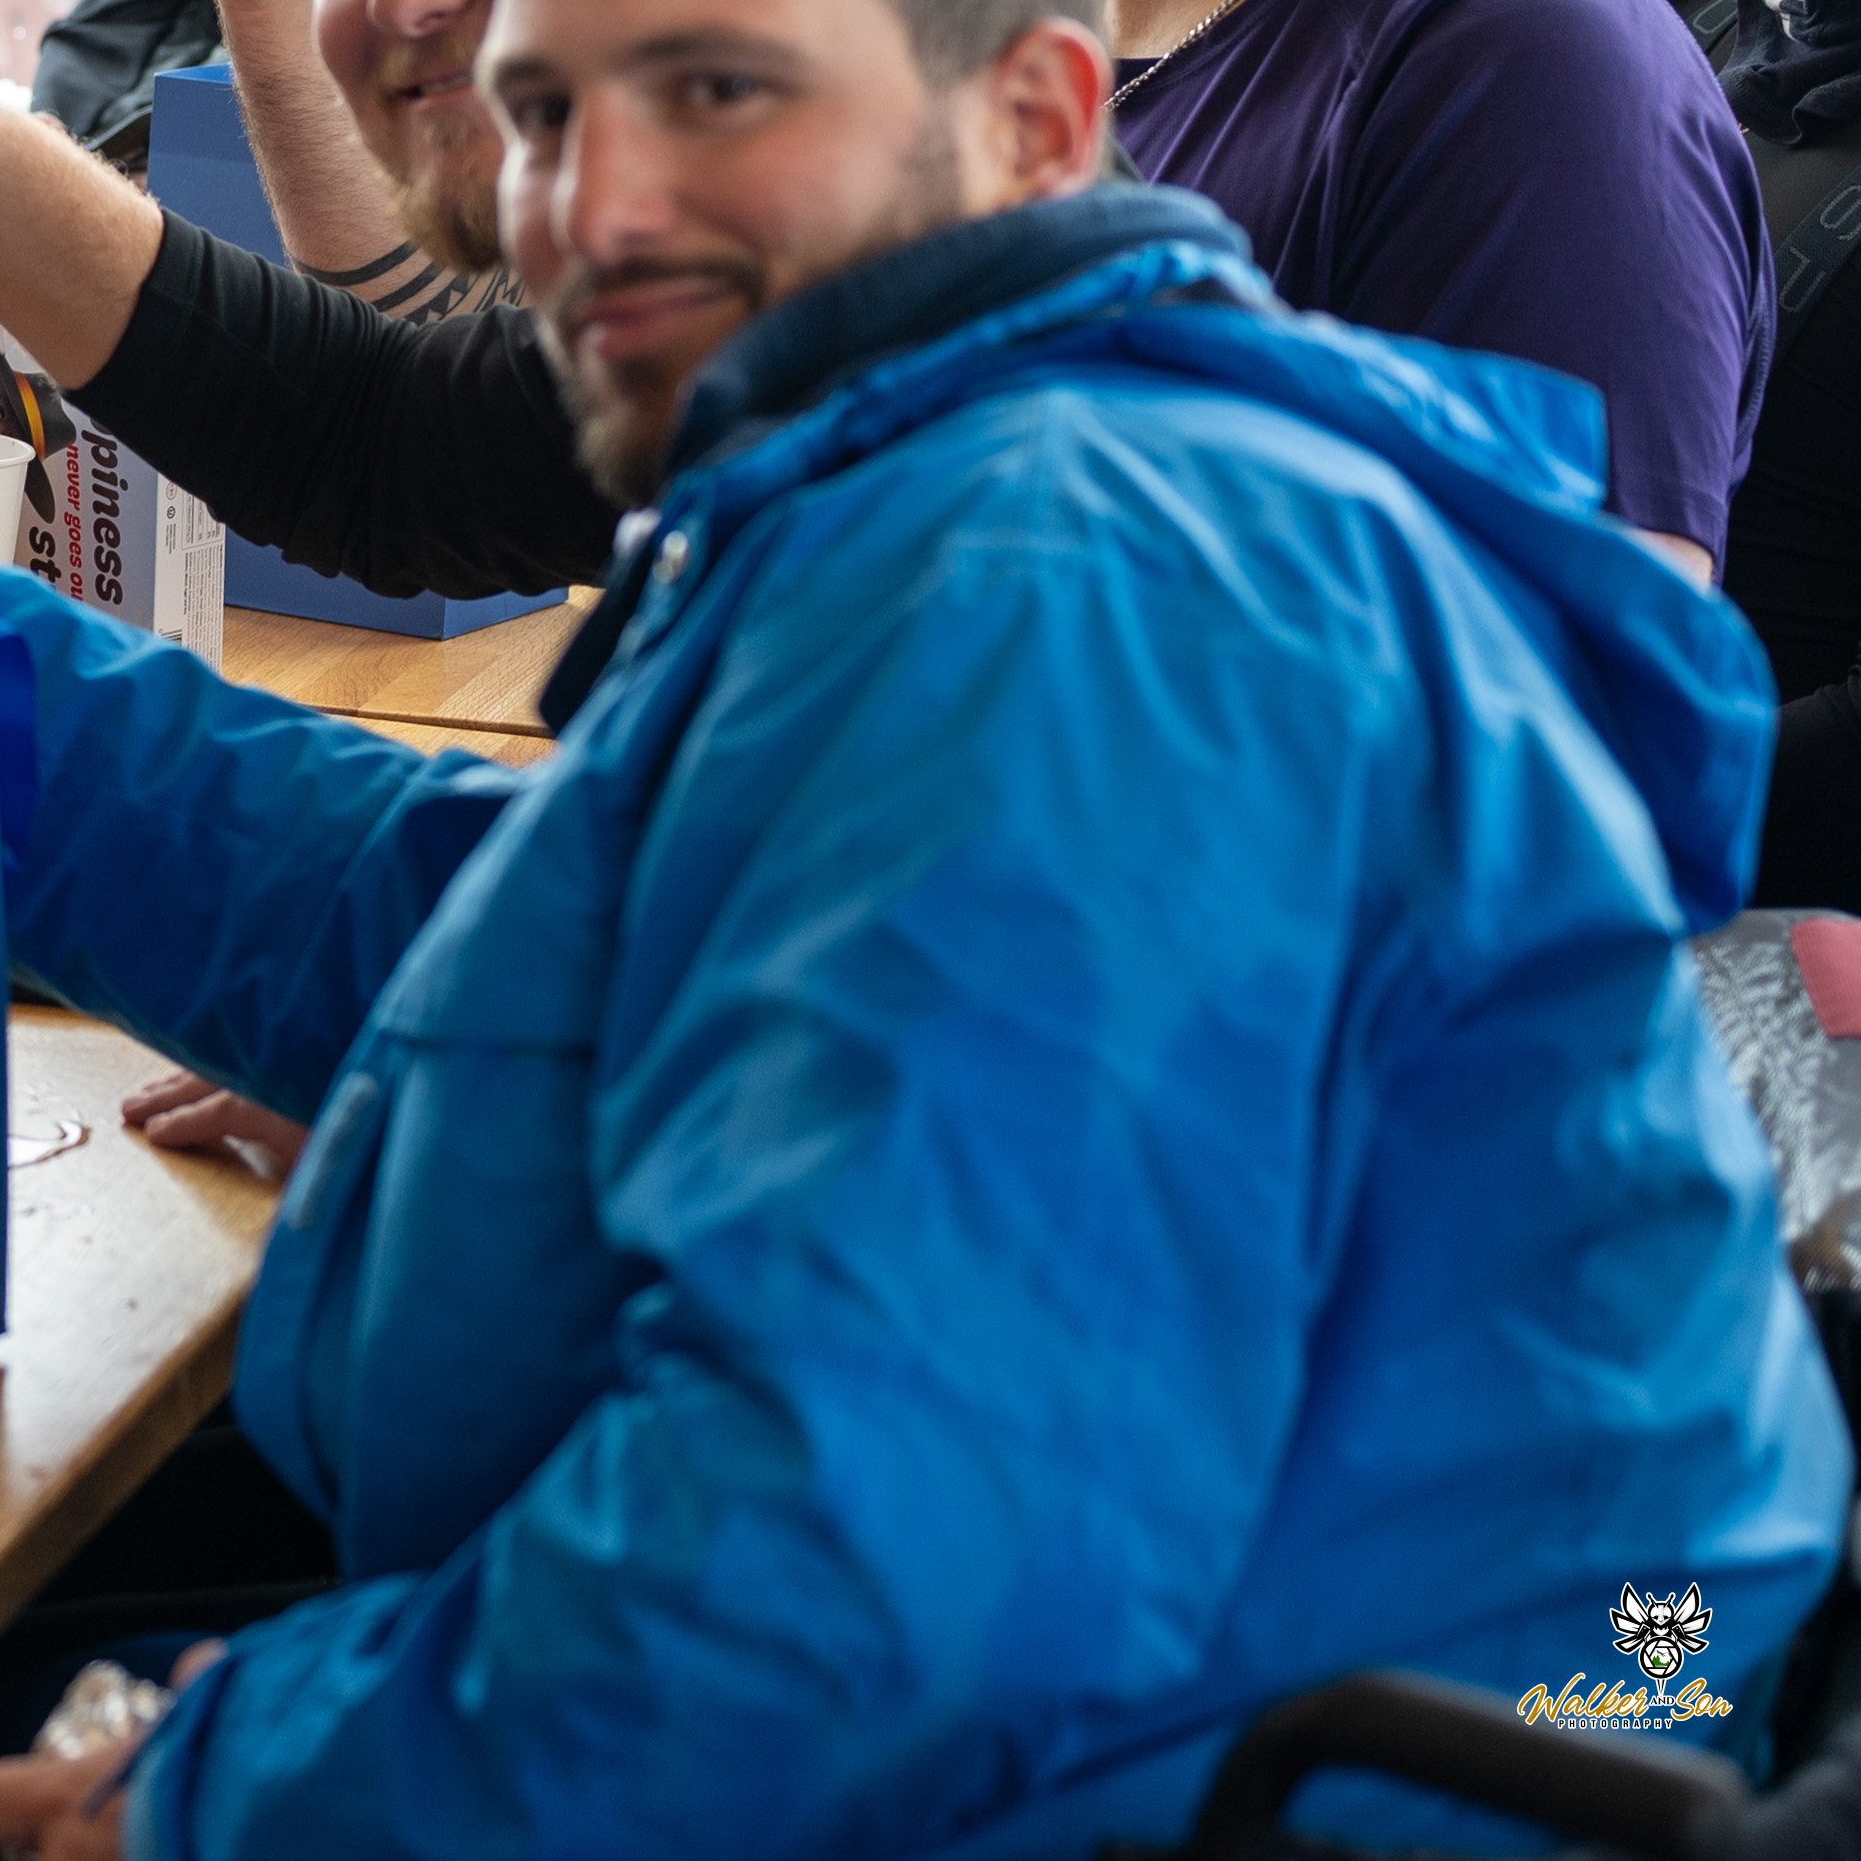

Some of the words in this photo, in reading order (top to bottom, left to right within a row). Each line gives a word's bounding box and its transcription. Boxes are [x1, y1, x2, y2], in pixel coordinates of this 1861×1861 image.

[66, 445, 81, 511] never
[64, 511, 83, 569] goes
[81, 417, 129, 606] piness
